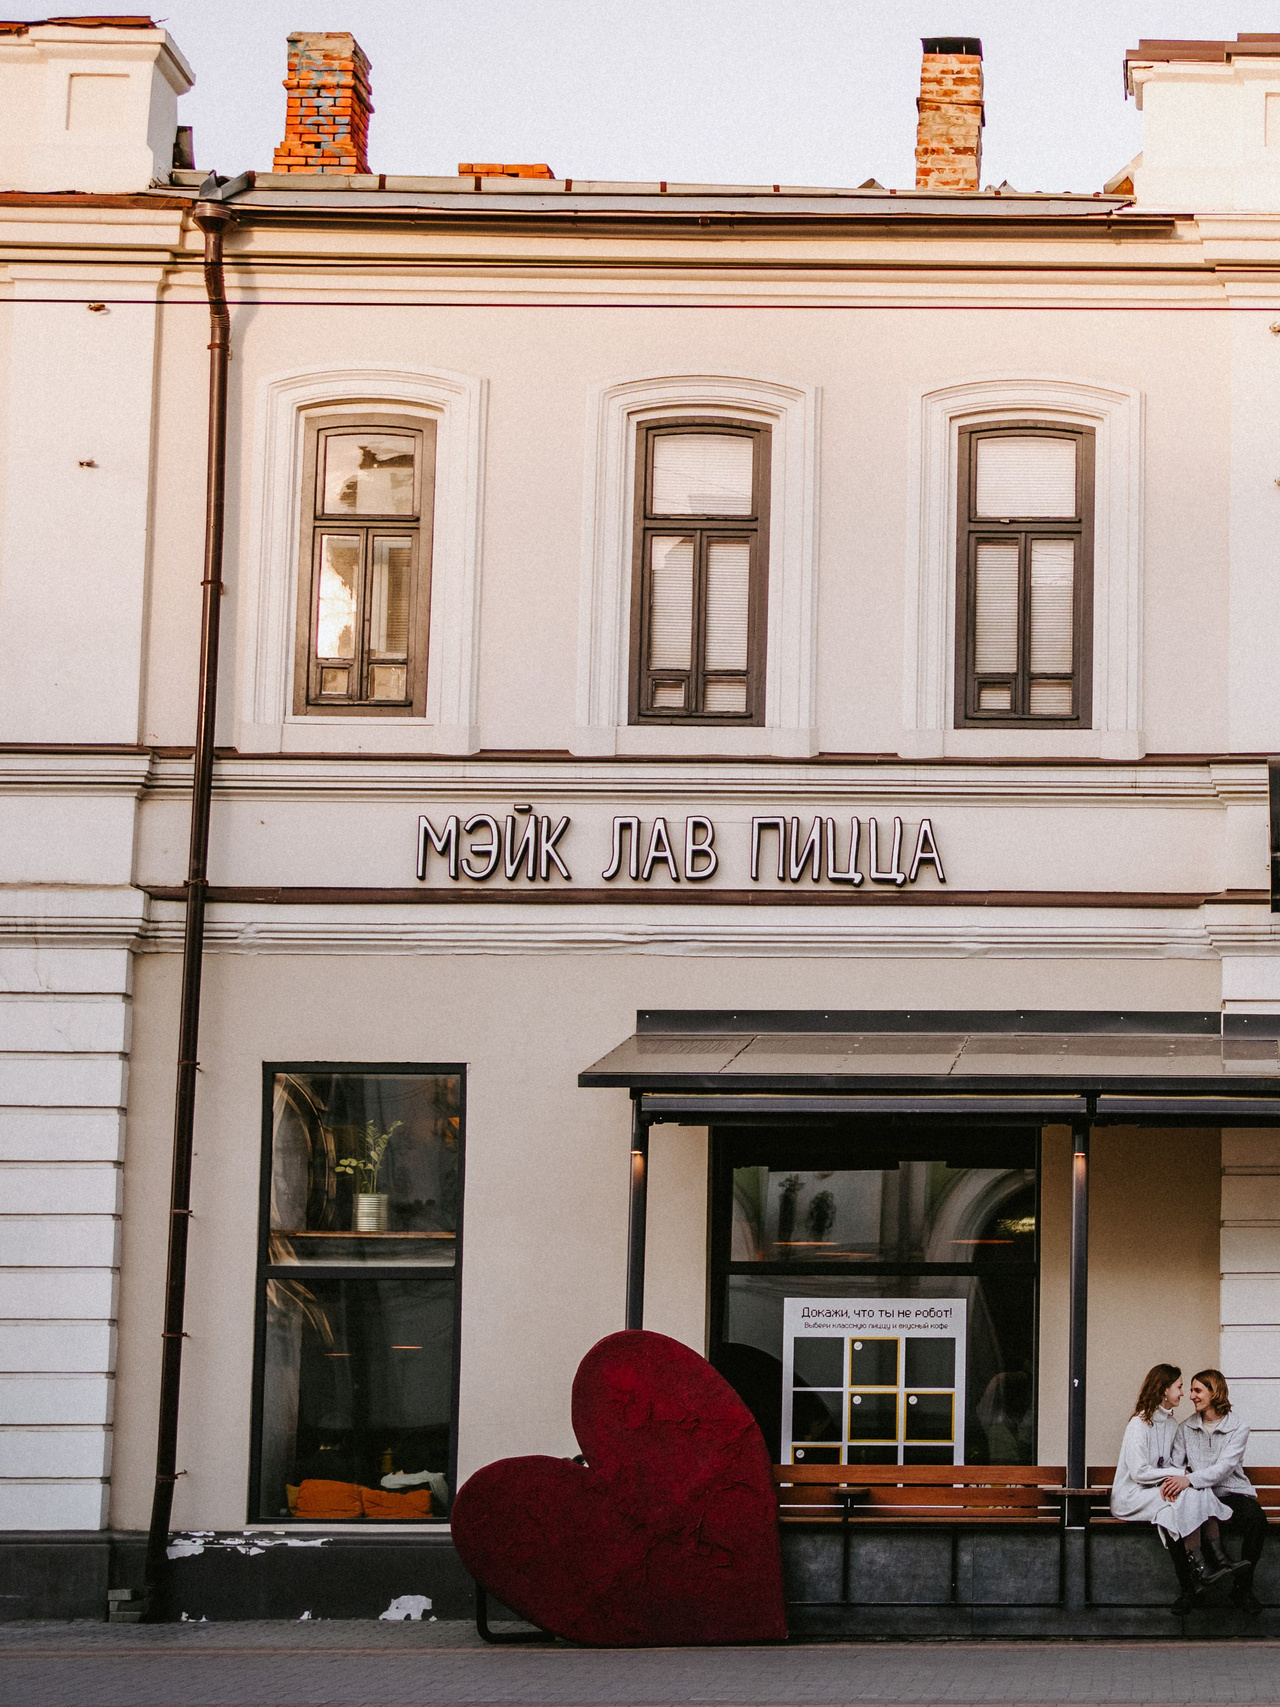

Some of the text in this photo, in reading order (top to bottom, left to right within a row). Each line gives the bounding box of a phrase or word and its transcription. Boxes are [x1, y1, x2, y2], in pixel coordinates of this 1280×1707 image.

[416, 804, 946, 887] МЭЙК ЛАВ ПИЦЦА
[801, 1307, 953, 1319] Докажи, что ты не робот!
